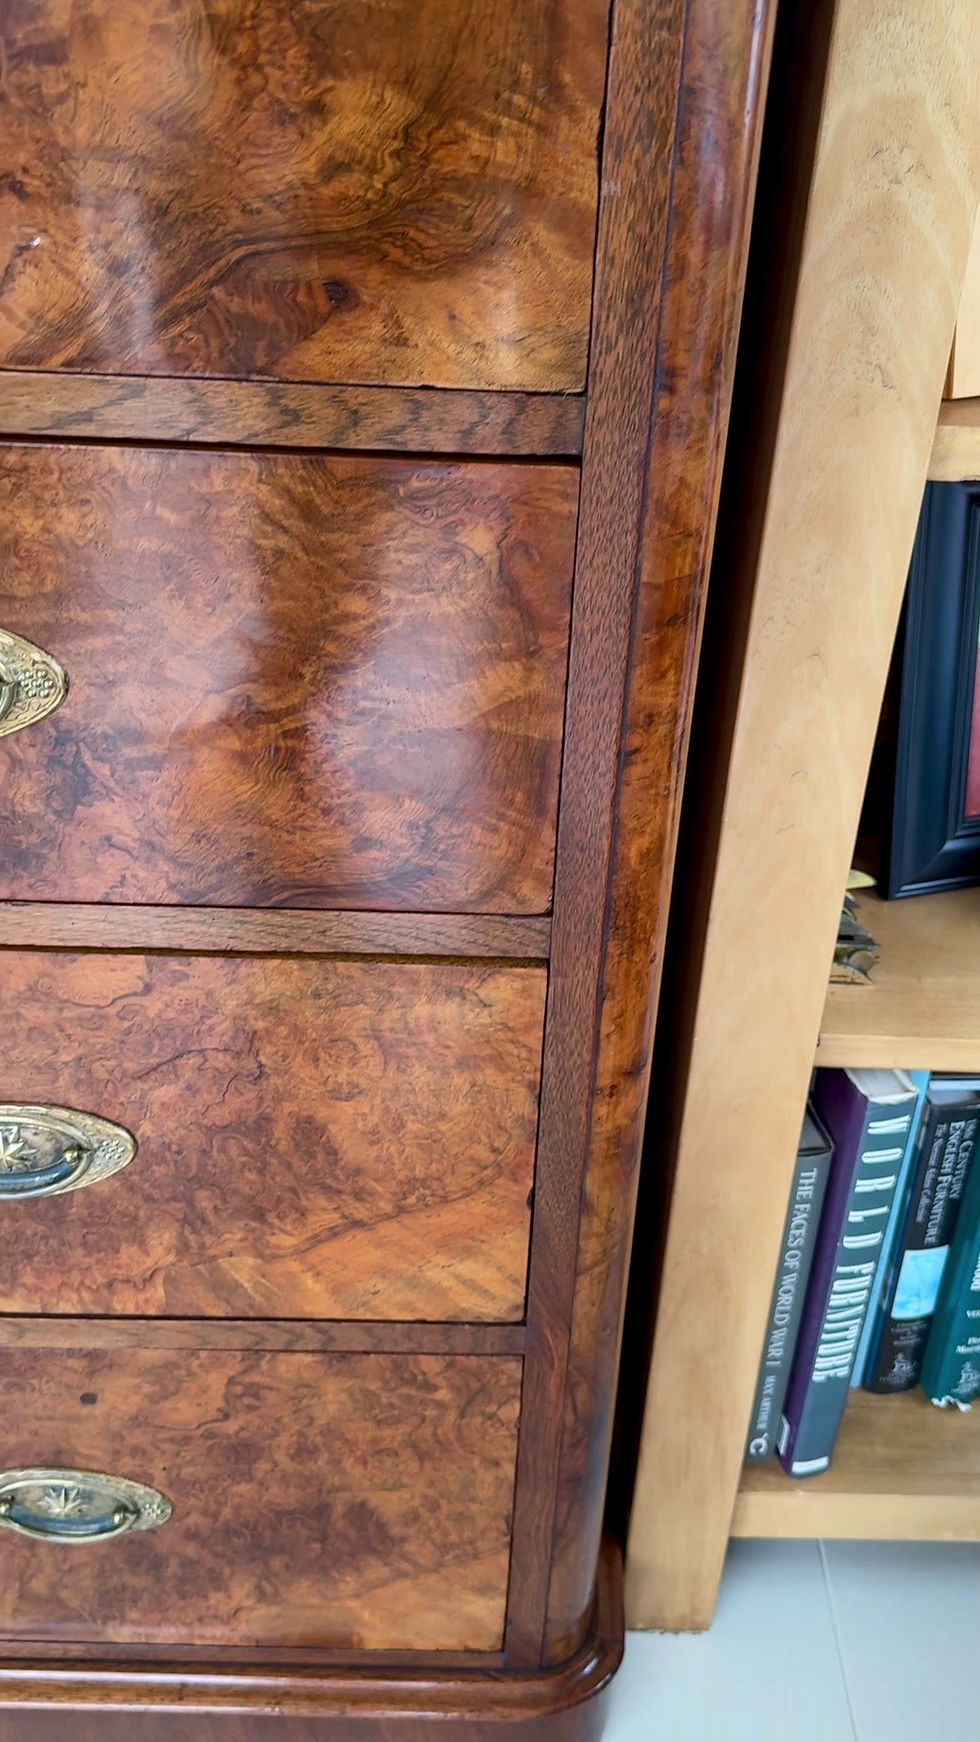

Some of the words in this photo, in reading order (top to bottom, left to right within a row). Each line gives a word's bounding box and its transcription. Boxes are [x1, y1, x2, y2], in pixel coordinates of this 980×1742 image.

[941, 1121, 966, 1175] ENGLISH
[949, 1140, 974, 1199] CENTURY
[795, 1167, 818, 1201] THE
[842, 1114, 911, 1249] WORLD
[787, 1203, 812, 1248] FACES
[923, 1175, 953, 1247] FURNITURE
[784, 1250, 802, 1269] OF
[773, 1273, 798, 1325] WORLD
[812, 1261, 875, 1383] FURNITURE
[766, 1327, 788, 1359] WAR
[762, 1375, 776, 1396] MAX
